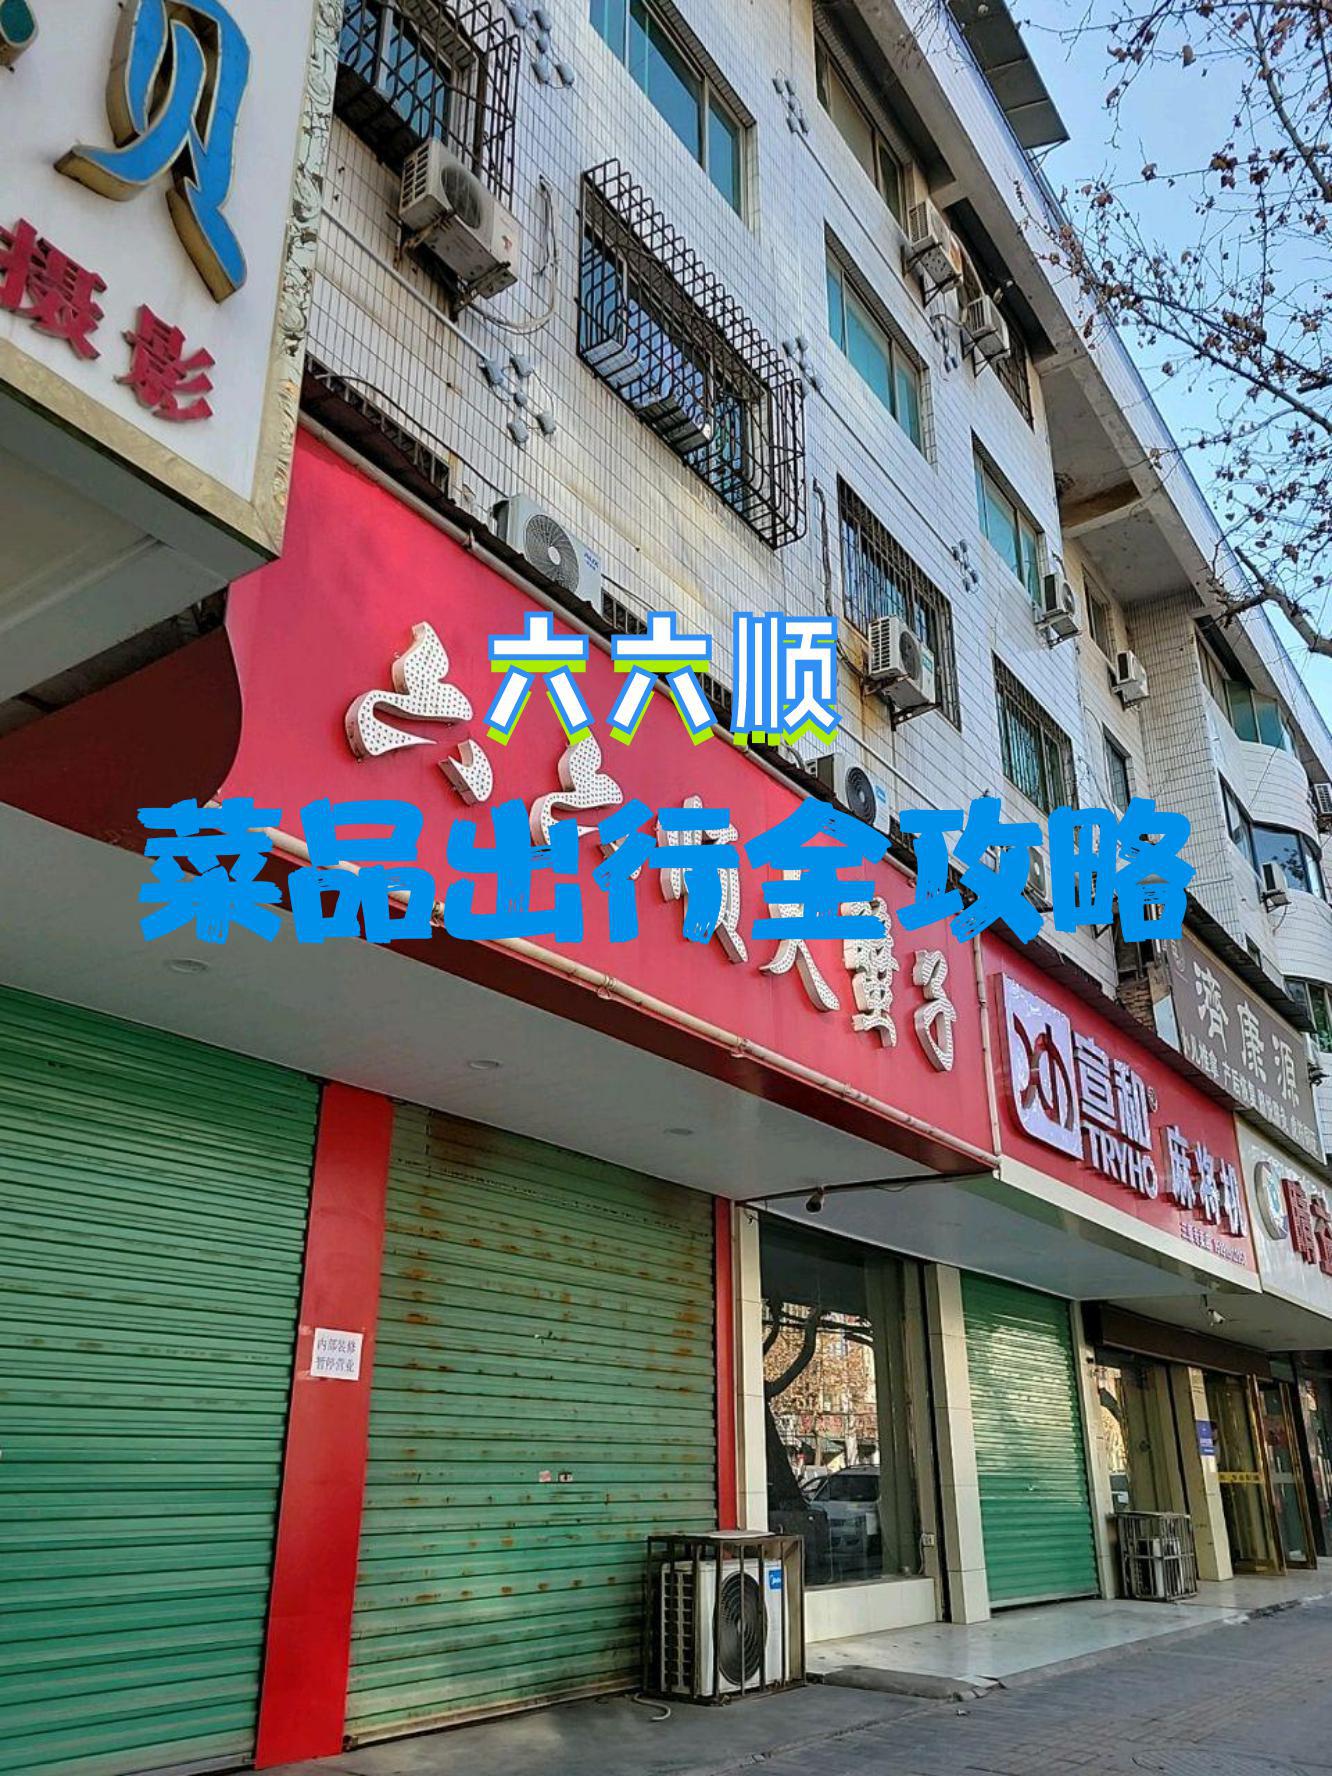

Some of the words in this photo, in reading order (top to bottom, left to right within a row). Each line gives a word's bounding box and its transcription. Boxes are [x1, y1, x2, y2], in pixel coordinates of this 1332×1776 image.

[0, 218, 216, 422] 摄影
[1073, 1031, 1153, 1151] 宣和
[1082, 1120, 1159, 1200] TRYHO
[1163, 1125, 1248, 1238] 麻将机
